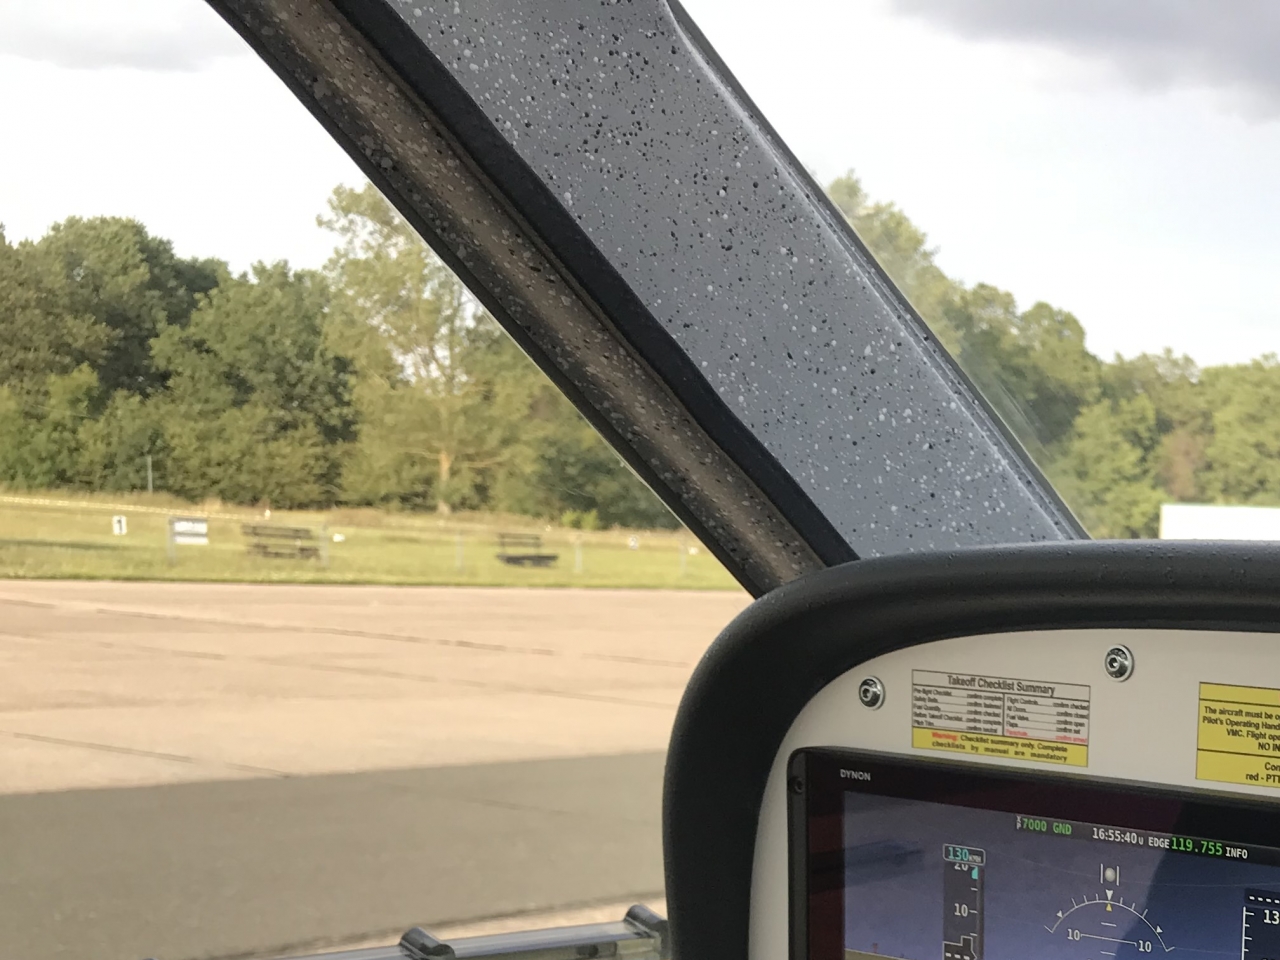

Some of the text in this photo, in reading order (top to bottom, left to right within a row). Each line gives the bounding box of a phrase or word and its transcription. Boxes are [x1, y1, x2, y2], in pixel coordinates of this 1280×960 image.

[947, 675, 1056, 697] Takeoff Checklist Summary
[1204, 706, 1217, 714] The
[1218, 707, 1244, 717] aircraft
[1245, 710, 1263, 720] must
[1264, 711, 1274, 720] be
[1202, 716, 1224, 726] Pilot's
[1225, 718, 1260, 731] Operating
[1226, 728, 1245, 738] VMC.
[1246, 730, 1267, 741] Flight
[932, 740, 966, 750] checklists
[1030, 752, 1068, 762] mandatory
[1037, 743, 1068, 753] Complete
[1257, 742, 1271, 751] NO
[840, 769, 871, 781] DYNON
[1245, 773, 1260, 782] red
[1022, 817, 1047, 832] 7000
[1053, 822, 1072, 835] GND
[1148, 837, 1170, 849] EDGE
[1172, 837, 1223, 856] 119.755
[1225, 846, 1248, 859] INFO
